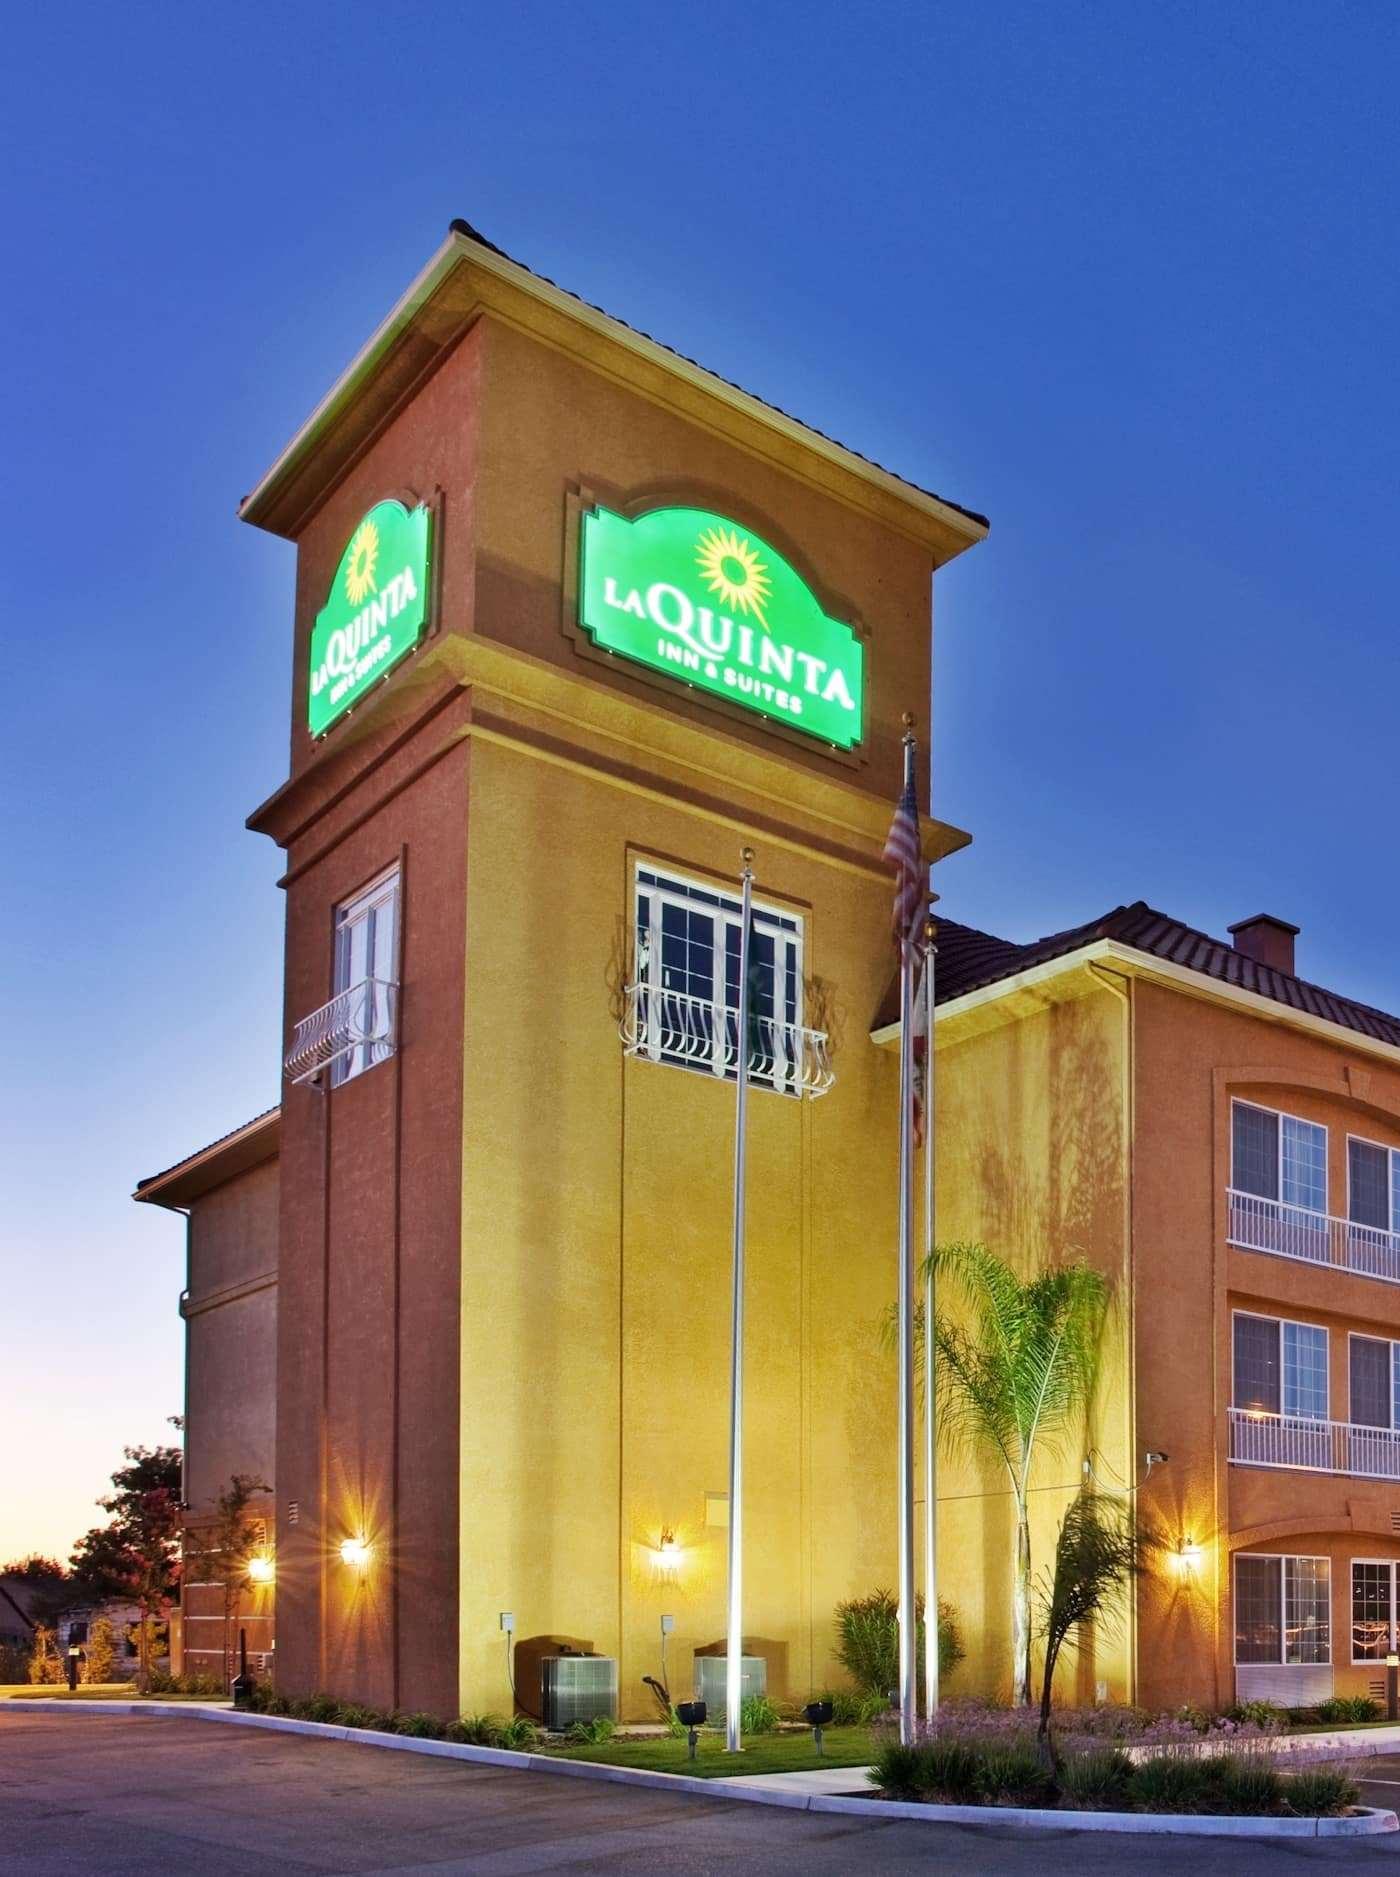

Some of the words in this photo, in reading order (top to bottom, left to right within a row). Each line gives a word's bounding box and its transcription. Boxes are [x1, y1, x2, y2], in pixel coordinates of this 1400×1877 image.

[325, 565, 418, 678] QUINTA
[645, 582, 856, 711] QUINTA
[657, 638, 700, 671] INN
[723, 667, 803, 714] SUITES
